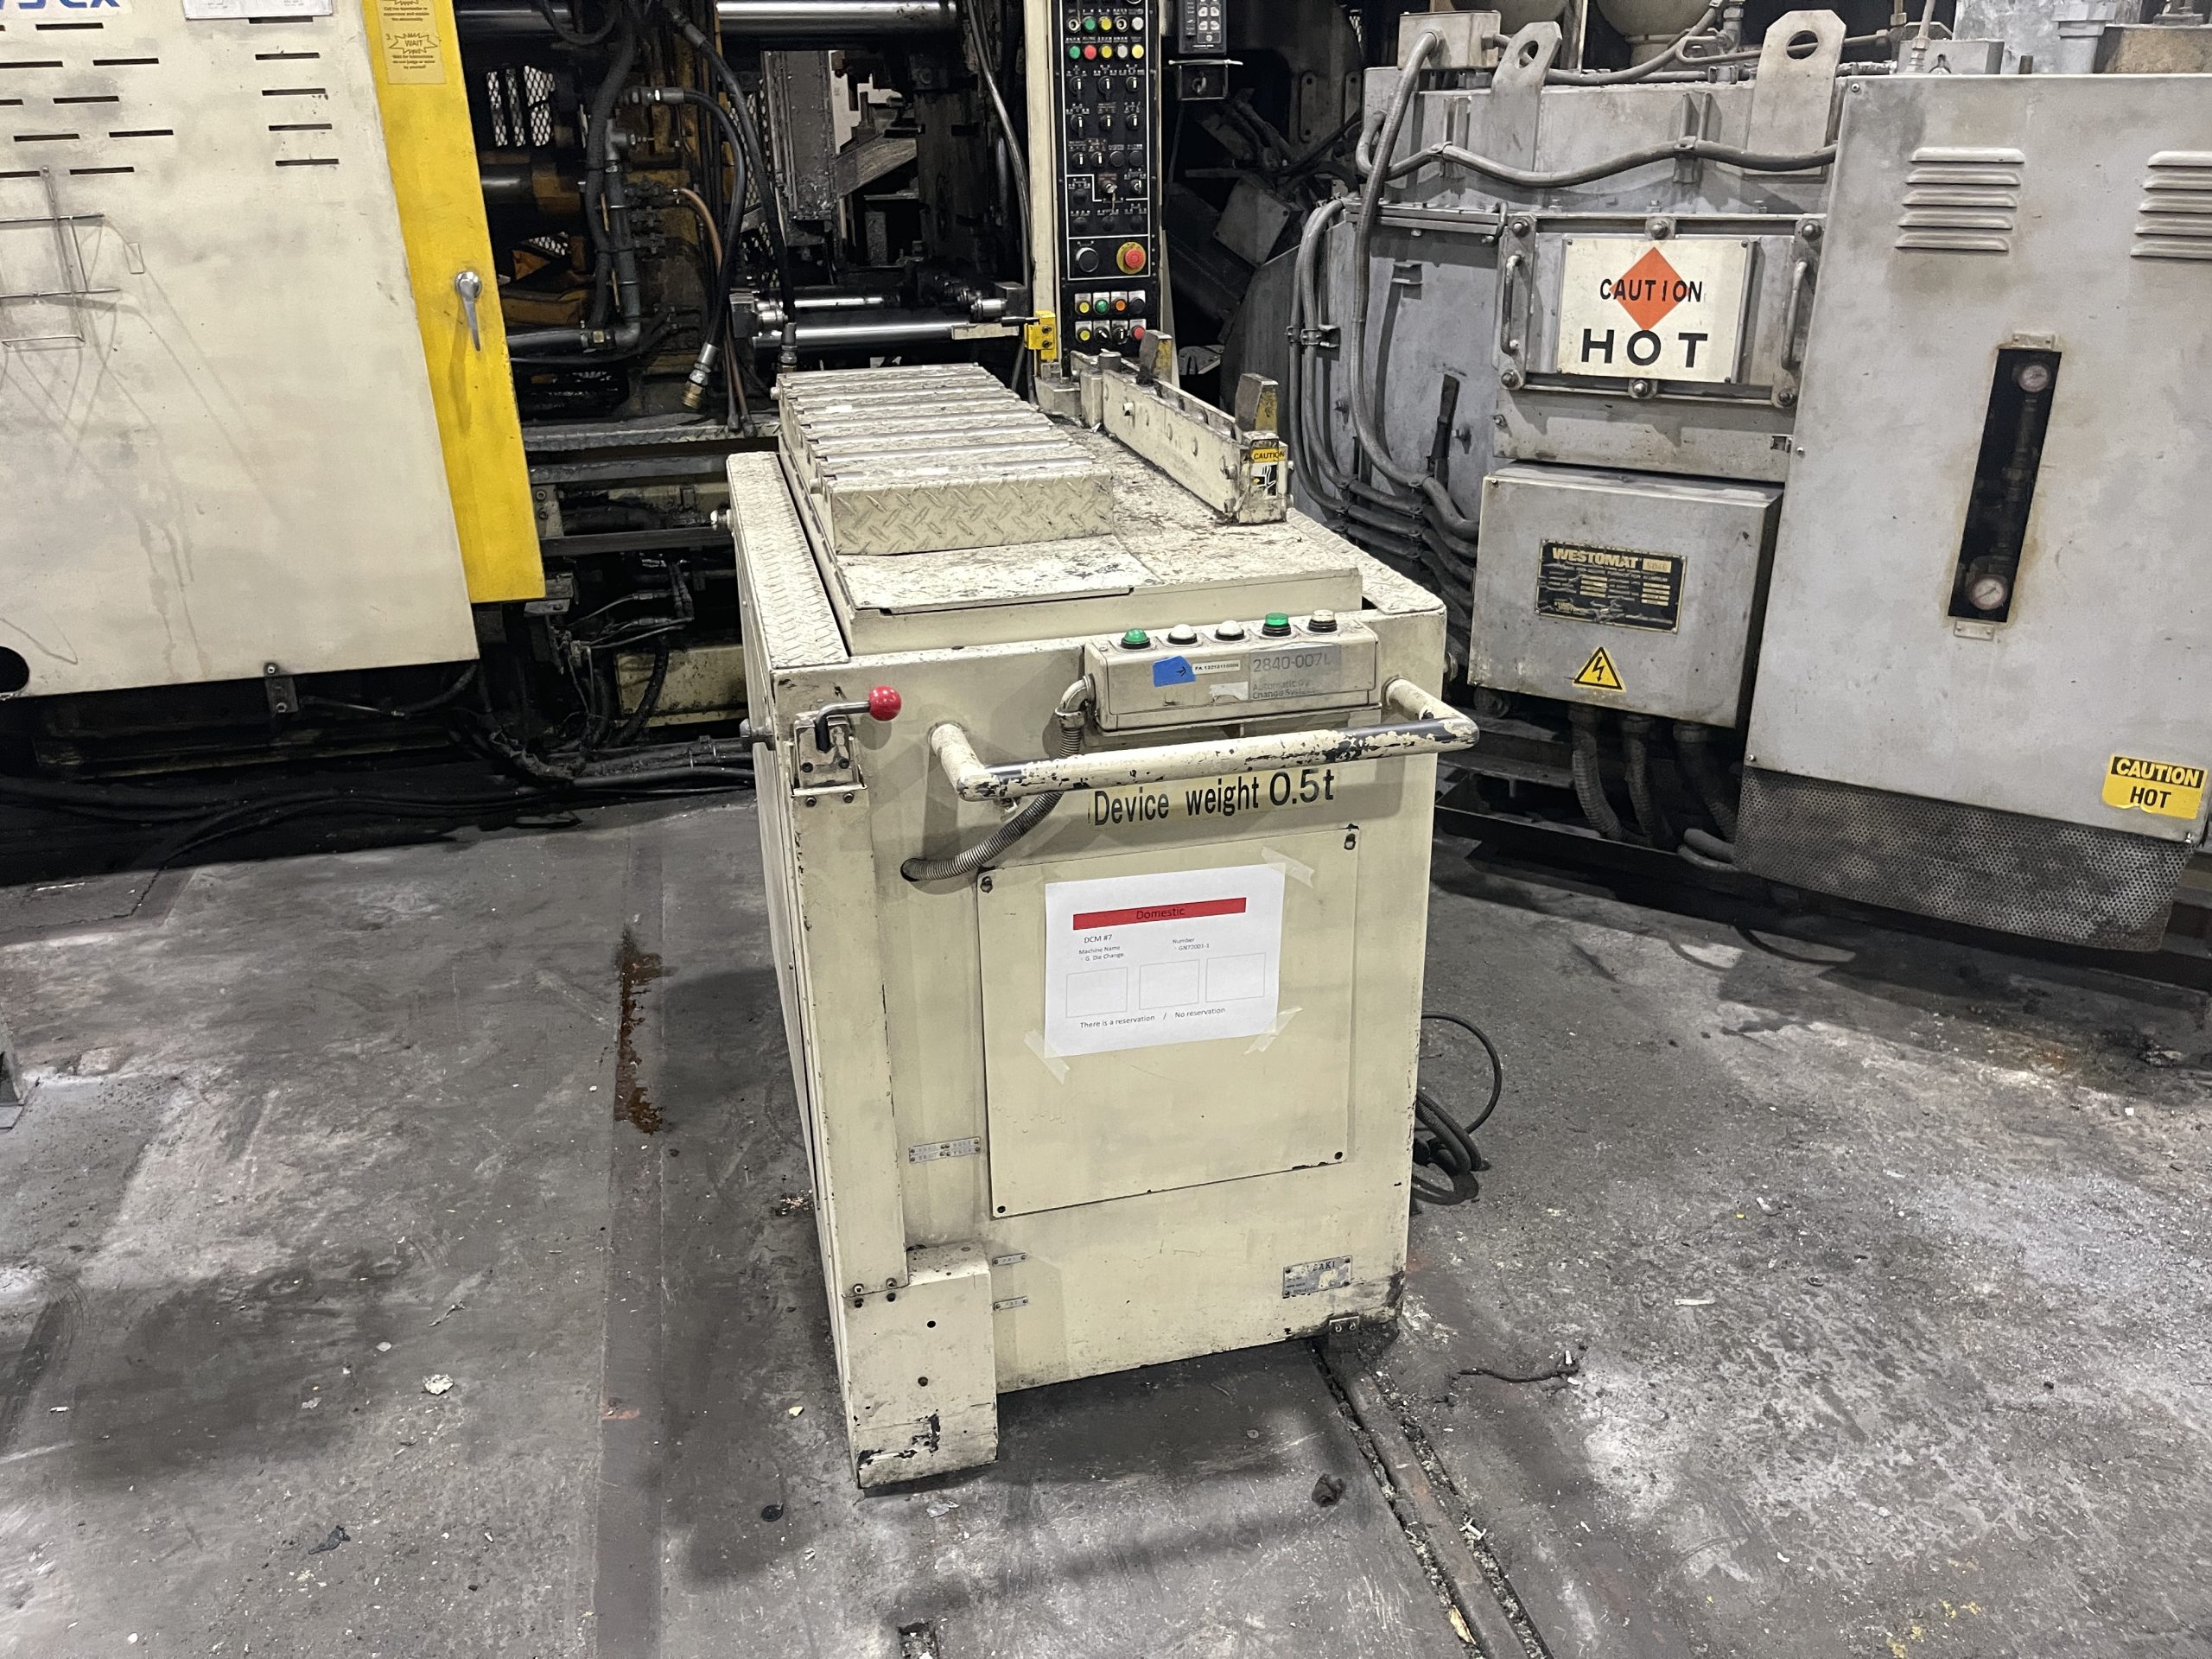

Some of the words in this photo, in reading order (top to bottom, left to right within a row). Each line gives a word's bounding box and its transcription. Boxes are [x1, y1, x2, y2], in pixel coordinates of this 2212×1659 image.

[1599, 277, 1702, 302] CAUTION
[1580, 327, 1708, 368] HOT
[1254, 450, 1284, 460] CAUTION
[1552, 547, 1639, 569] WESTOMAT
[2116, 758, 2200, 787] CAUTION
[1094, 786, 1169, 826] Device
[1185, 776, 1259, 817] weight
[1268, 767, 1335, 807] 0.5t
[2130, 785, 2171, 809] HOT
[1135, 907, 1185, 920] Domestic
[1080, 1020, 1101, 1029] There
[1116, 1014, 1155, 1025] reservation
[1162, 1012, 1167, 1020] /
[1186, 1007, 1225, 1017] reservation
